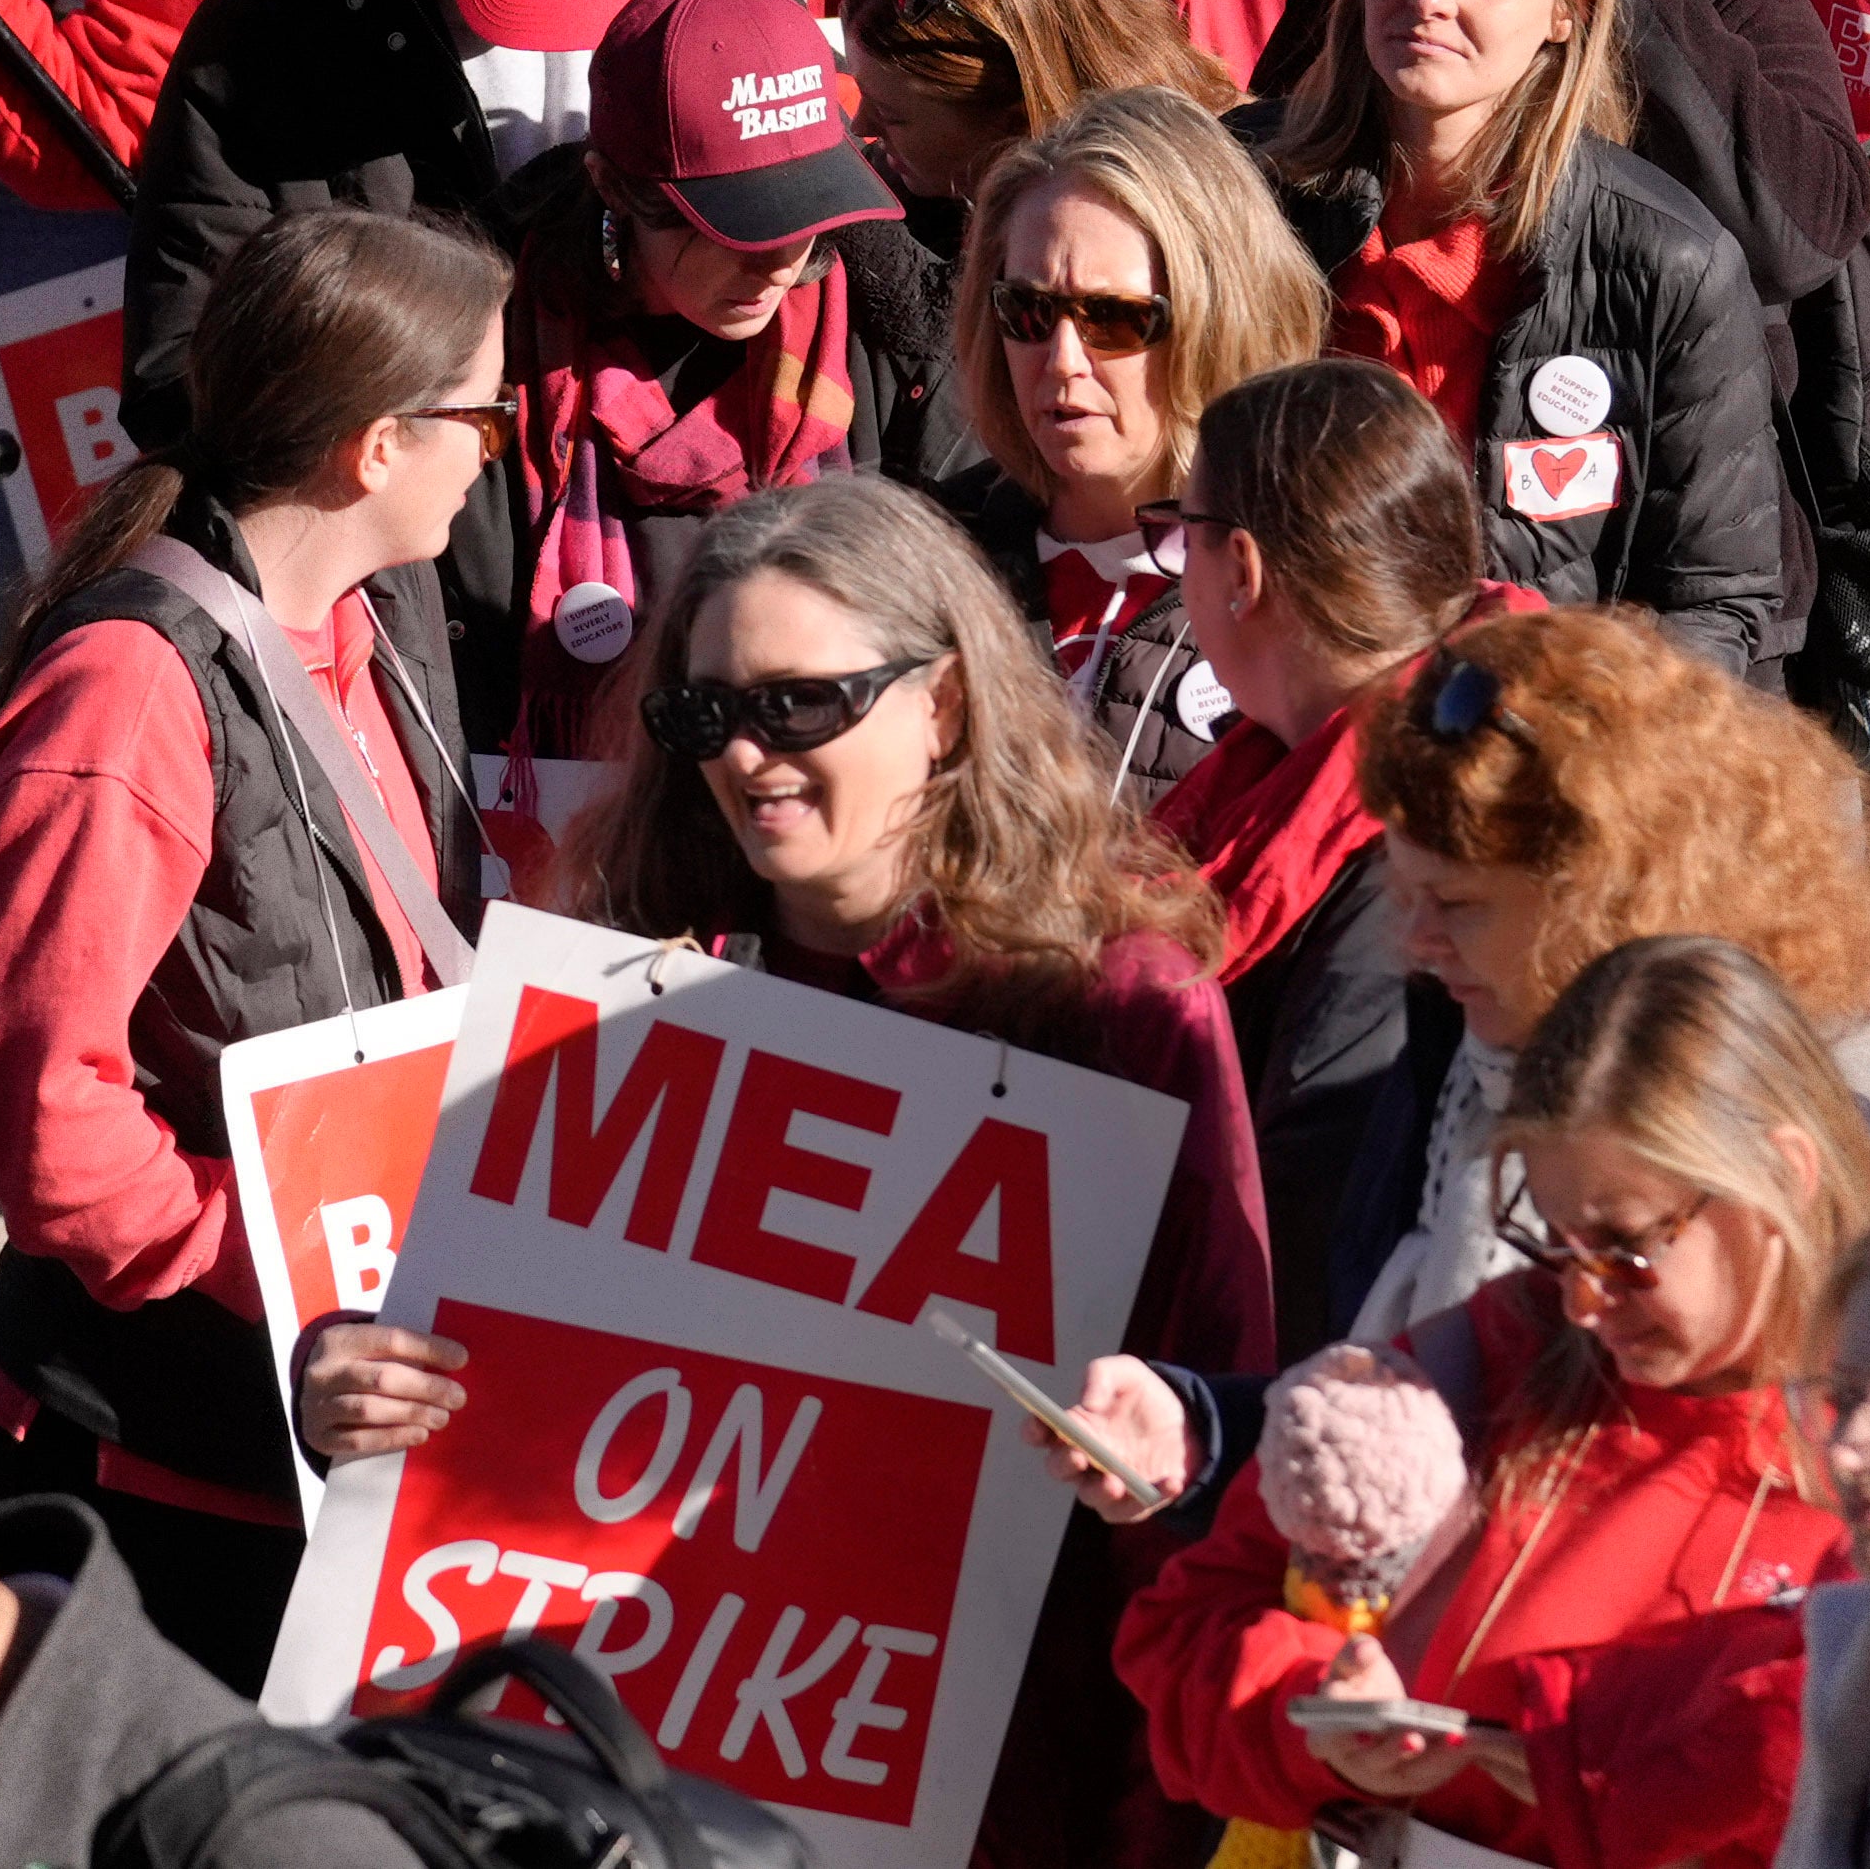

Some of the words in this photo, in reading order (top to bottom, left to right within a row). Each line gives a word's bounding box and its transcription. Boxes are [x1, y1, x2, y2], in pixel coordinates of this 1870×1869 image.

[1550, 385, 1589, 409] BEVERLY
[1558, 374, 1599, 401] SUPPORT
[1536, 391, 1591, 425] EDUCATORS
[569, 600, 610, 622] SUPPORT
[1197, 695, 1229, 709] BEVER
[469, 983, 1056, 1365] MEA
[573, 1366, 824, 1553] ON
[367, 1538, 938, 1786] STRIKE
